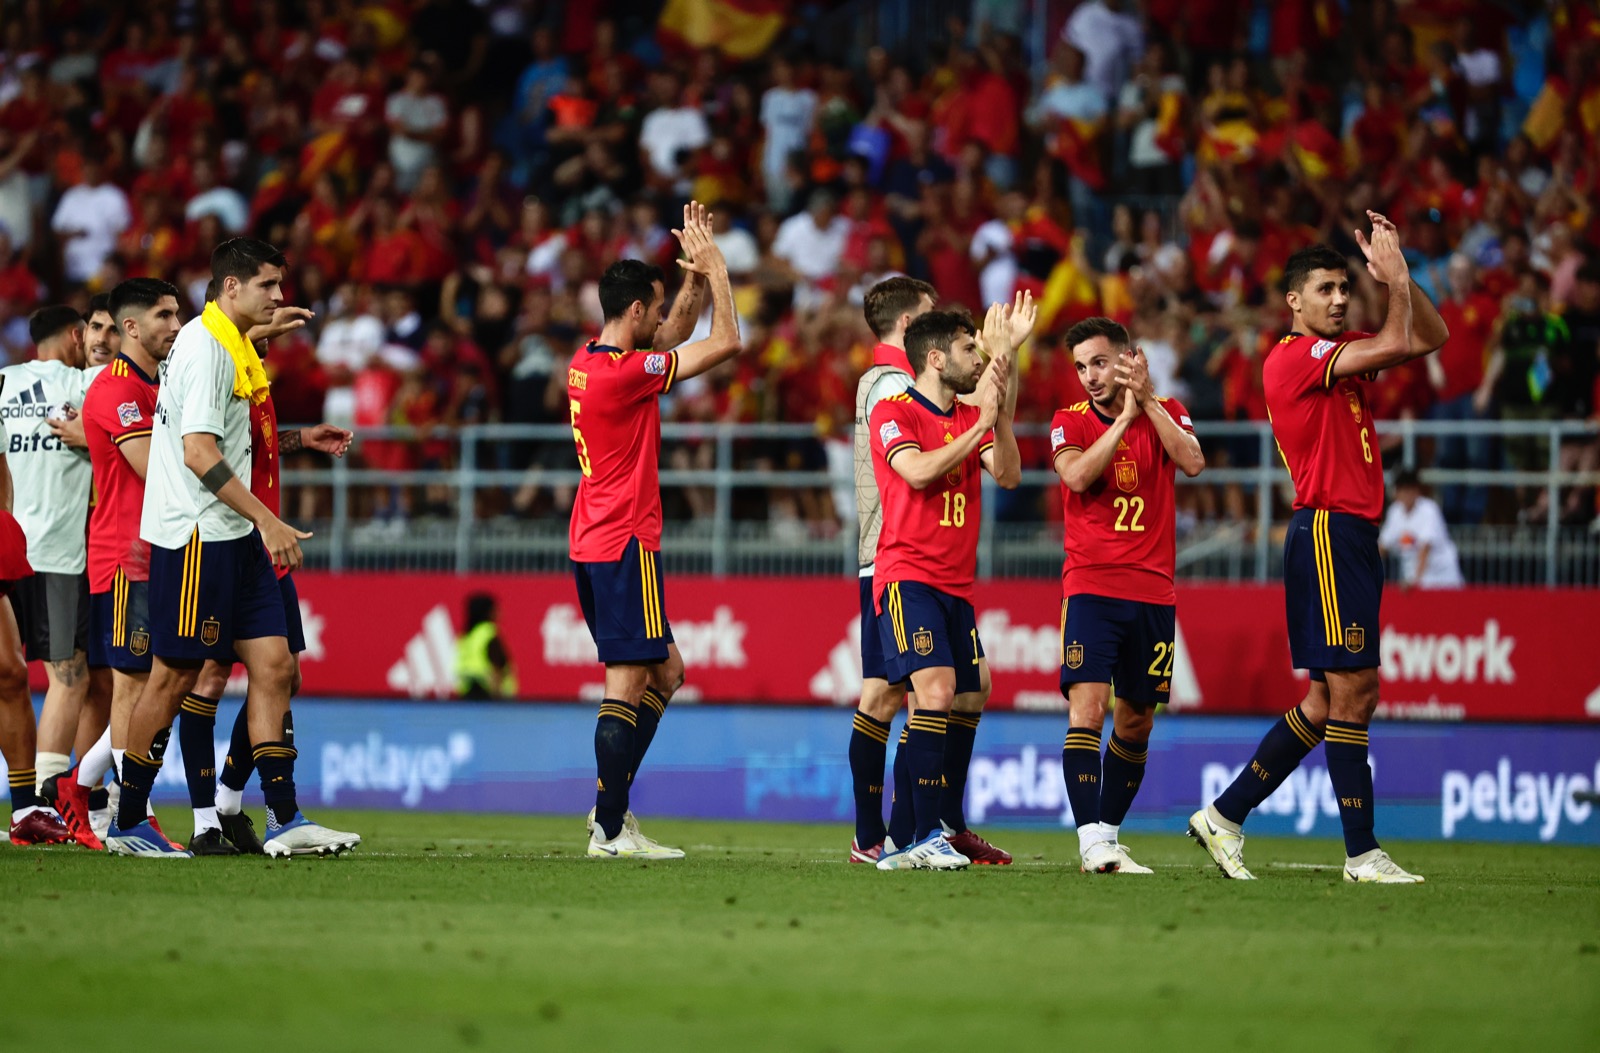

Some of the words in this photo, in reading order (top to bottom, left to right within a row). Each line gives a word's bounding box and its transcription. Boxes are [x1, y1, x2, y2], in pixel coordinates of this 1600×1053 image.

[570, 400, 592, 479] 5
[1360, 427, 1373, 464] 6
[939, 490, 966, 528] 18
[1113, 495, 1145, 532] 22
[1147, 641, 1174, 677] 22
